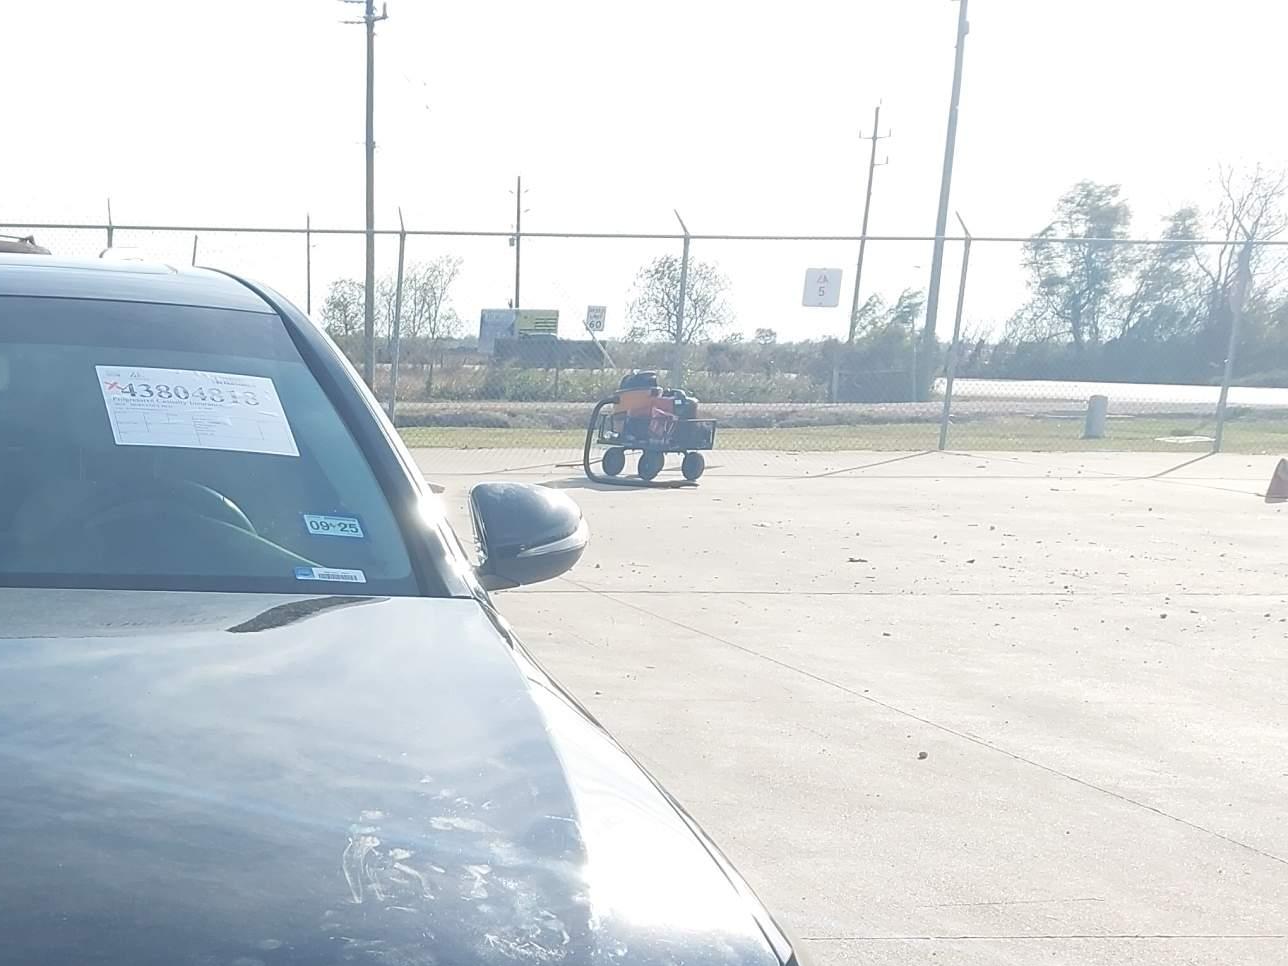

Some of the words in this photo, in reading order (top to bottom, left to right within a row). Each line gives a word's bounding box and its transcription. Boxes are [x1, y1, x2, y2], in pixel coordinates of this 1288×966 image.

[818, 286, 825, 297] 5
[588, 320, 602, 329] 60
[309, 520, 330, 531] 09
[337, 522, 359, 533] 25
